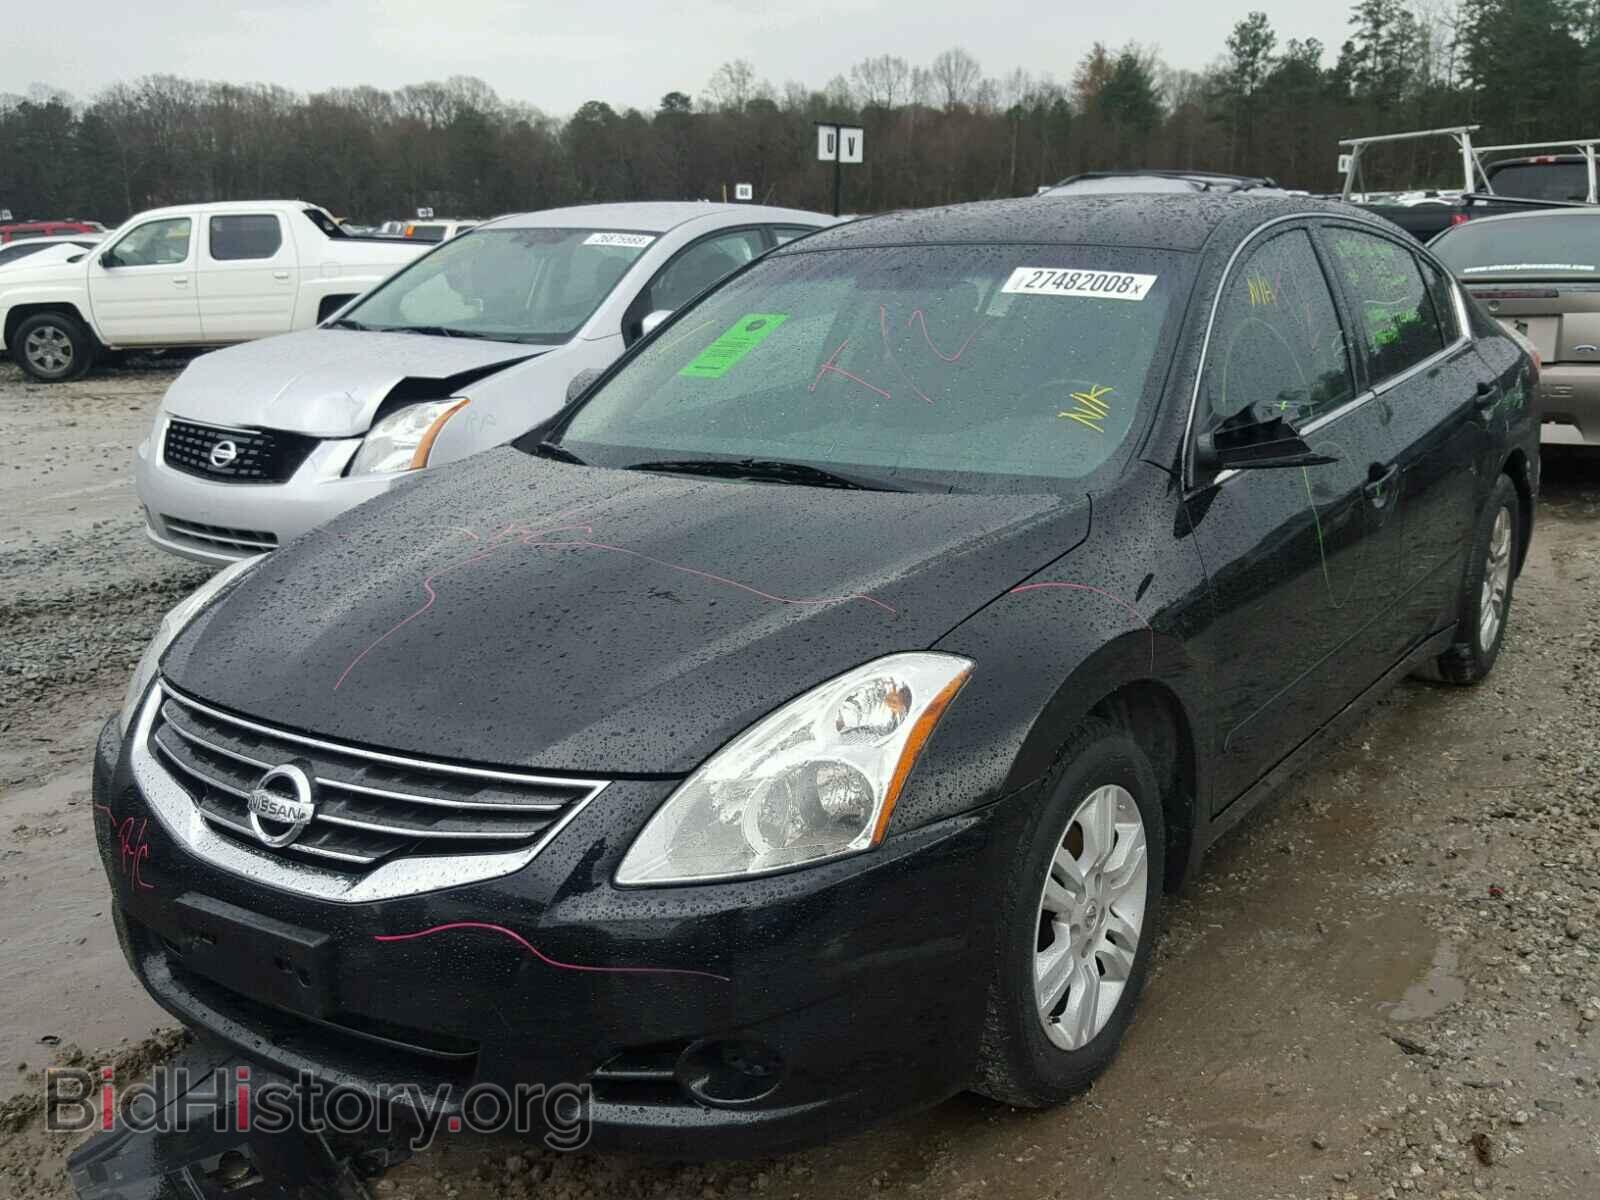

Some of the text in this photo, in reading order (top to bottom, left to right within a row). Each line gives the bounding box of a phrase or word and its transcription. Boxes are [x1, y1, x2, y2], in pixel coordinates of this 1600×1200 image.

[827, 133, 856, 157] U V
[248, 791, 303, 821] NISSAN
